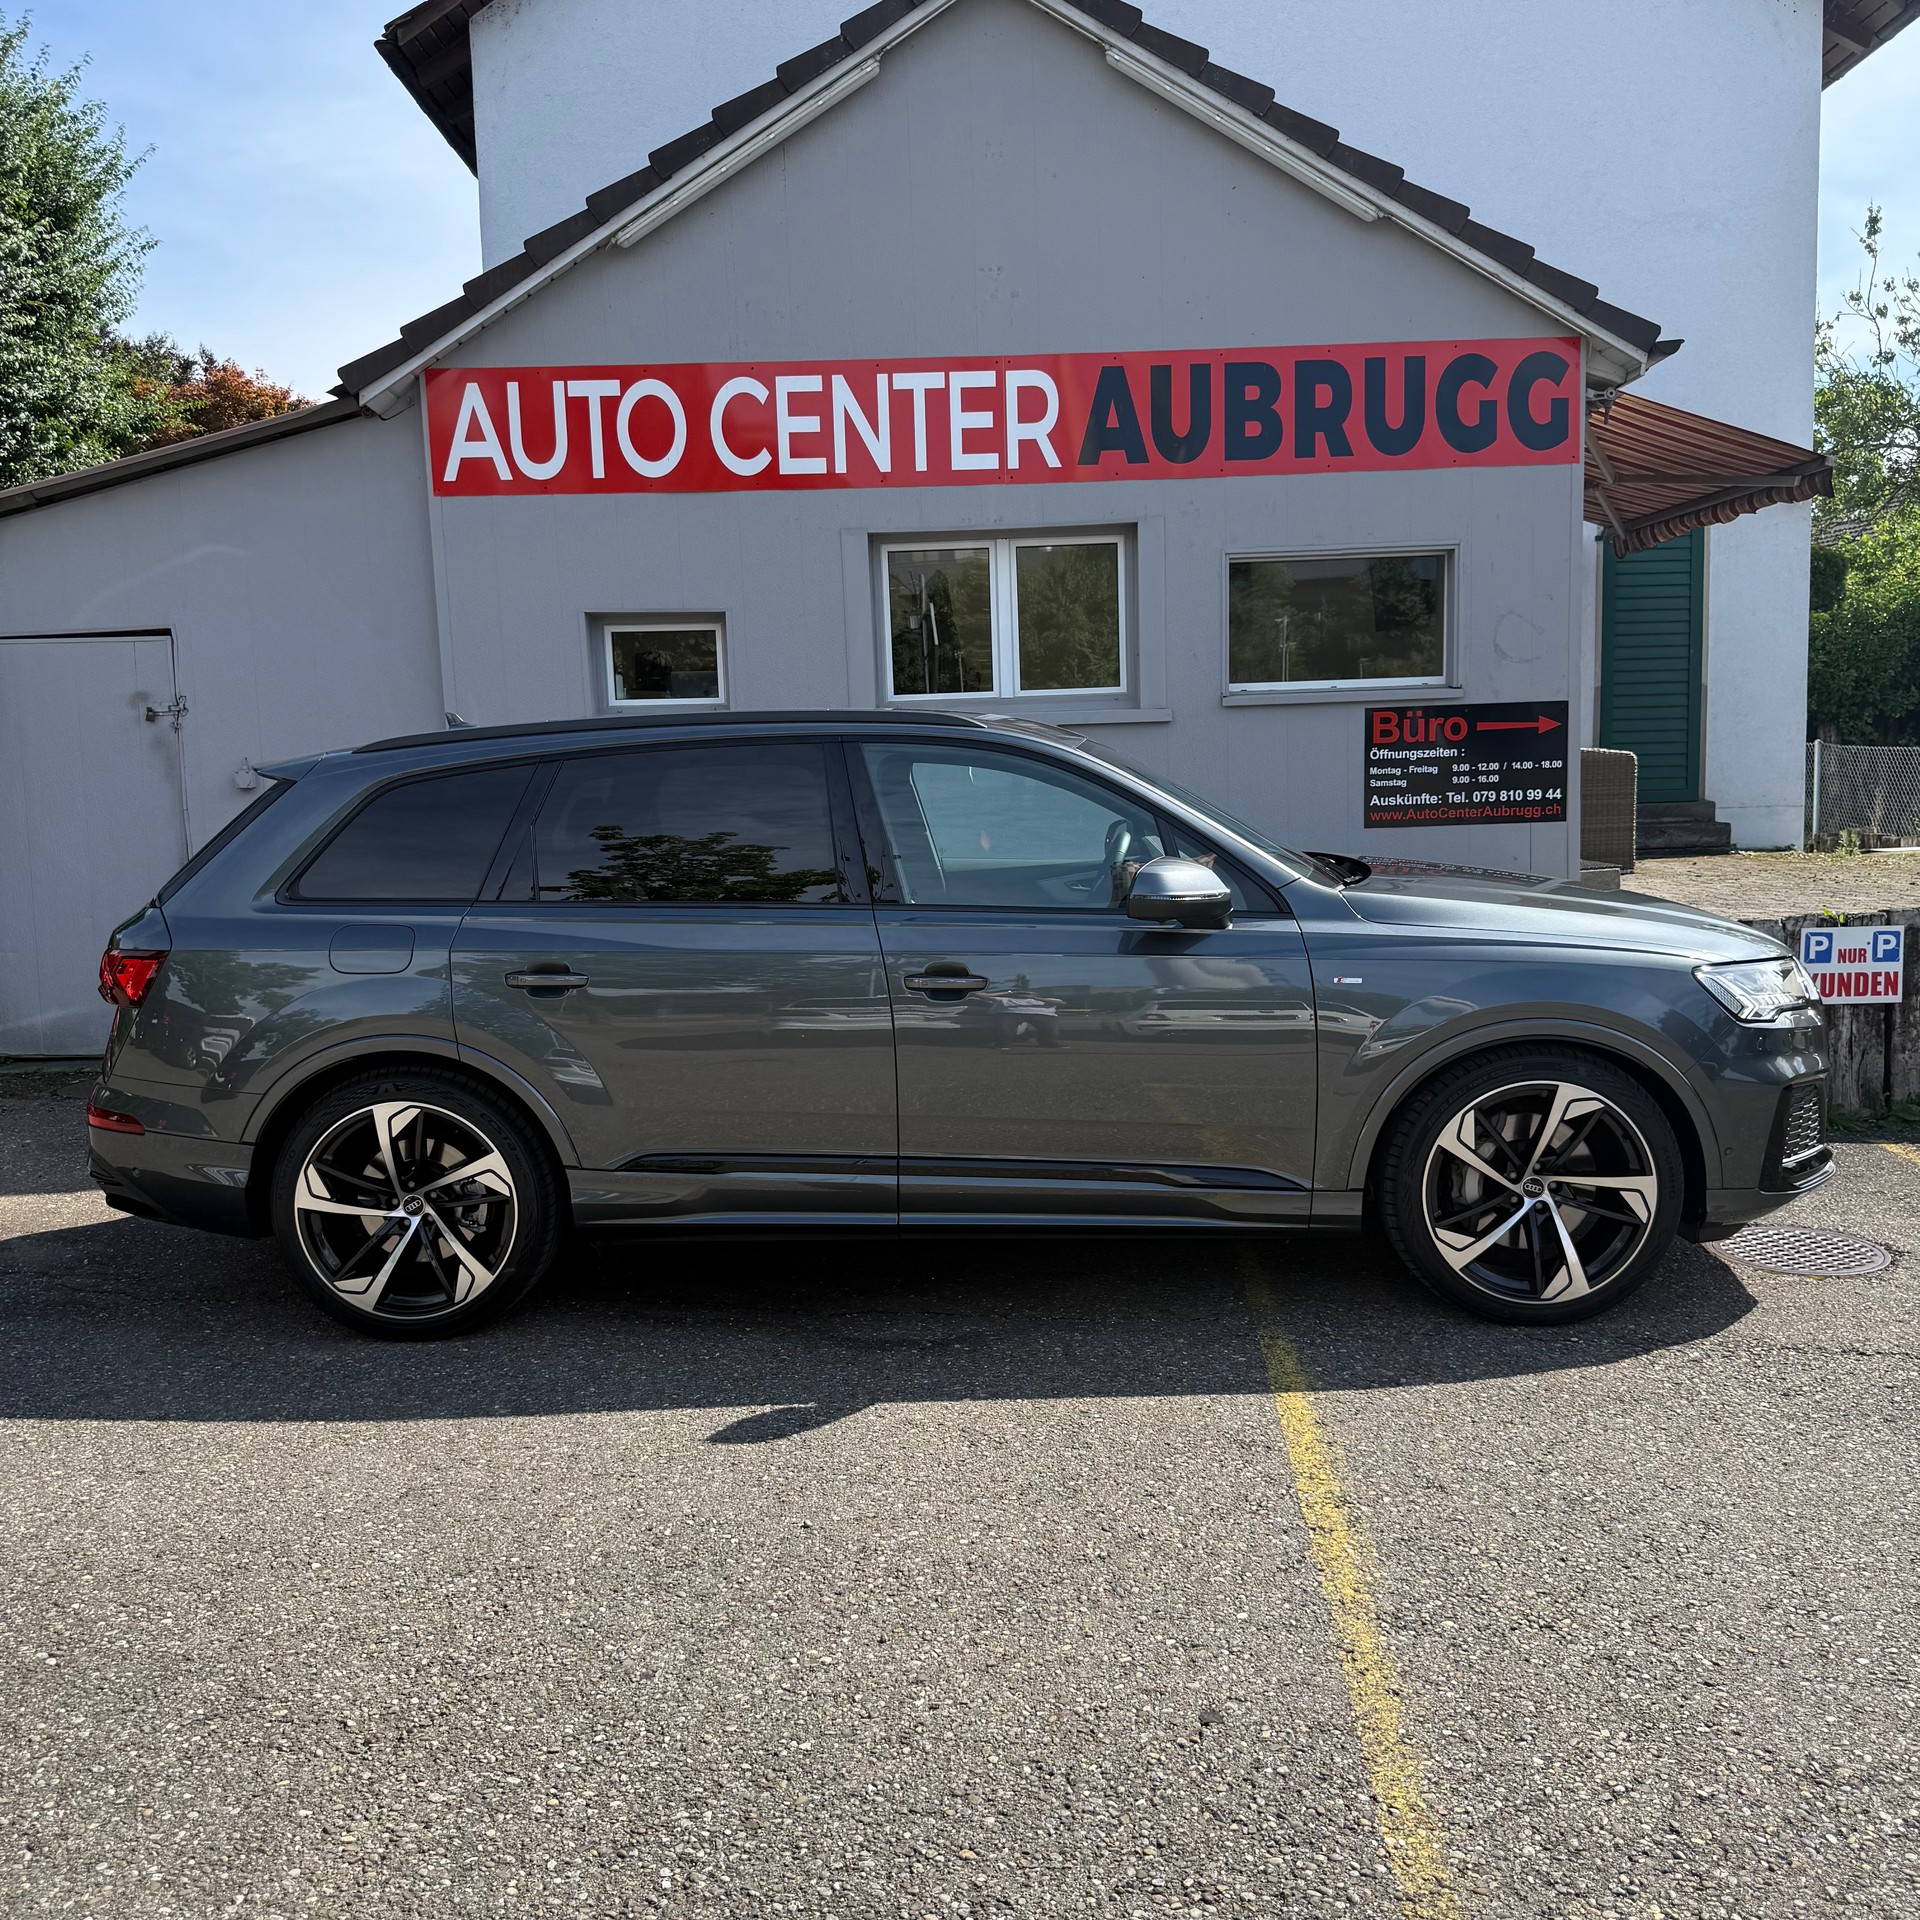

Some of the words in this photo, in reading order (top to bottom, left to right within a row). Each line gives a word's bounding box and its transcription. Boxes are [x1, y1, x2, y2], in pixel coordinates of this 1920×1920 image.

[443, 378, 687, 481] AUTO
[710, 369, 1062, 477] CENTER
[1077, 351, 1571, 466] AUBRUGG
[1372, 710, 1468, 744] Büro
[1369, 747, 1458, 760] Öffnungszeiten
[1369, 766, 1402, 776] Montag
[1409, 765, 1438, 775] Freitag
[1452, 763, 1470, 772] 9.00
[1477, 762, 1500, 771] 12.00
[1511, 761, 1533, 770] 14.00
[1541, 760, 1562, 769] 18.00
[1369, 778, 1407, 788] Samstag
[1452, 775, 1470, 784] 9.00
[1477, 774, 1500, 783] 16.00
[1369, 793, 1442, 806] Auskünfte:
[1446, 792, 1469, 803] Tel.
[1472, 790, 1496, 803] 079
[1499, 790, 1523, 802] 810
[1526, 789, 1542, 801] 99
[1545, 788, 1562, 800] 44
[1369, 803, 1562, 821] www.AutoCenterAubrugg.ch
[1808, 935, 1830, 960] P
[1837, 948, 1867, 964] NUR
[1876, 934, 1897, 958] P
